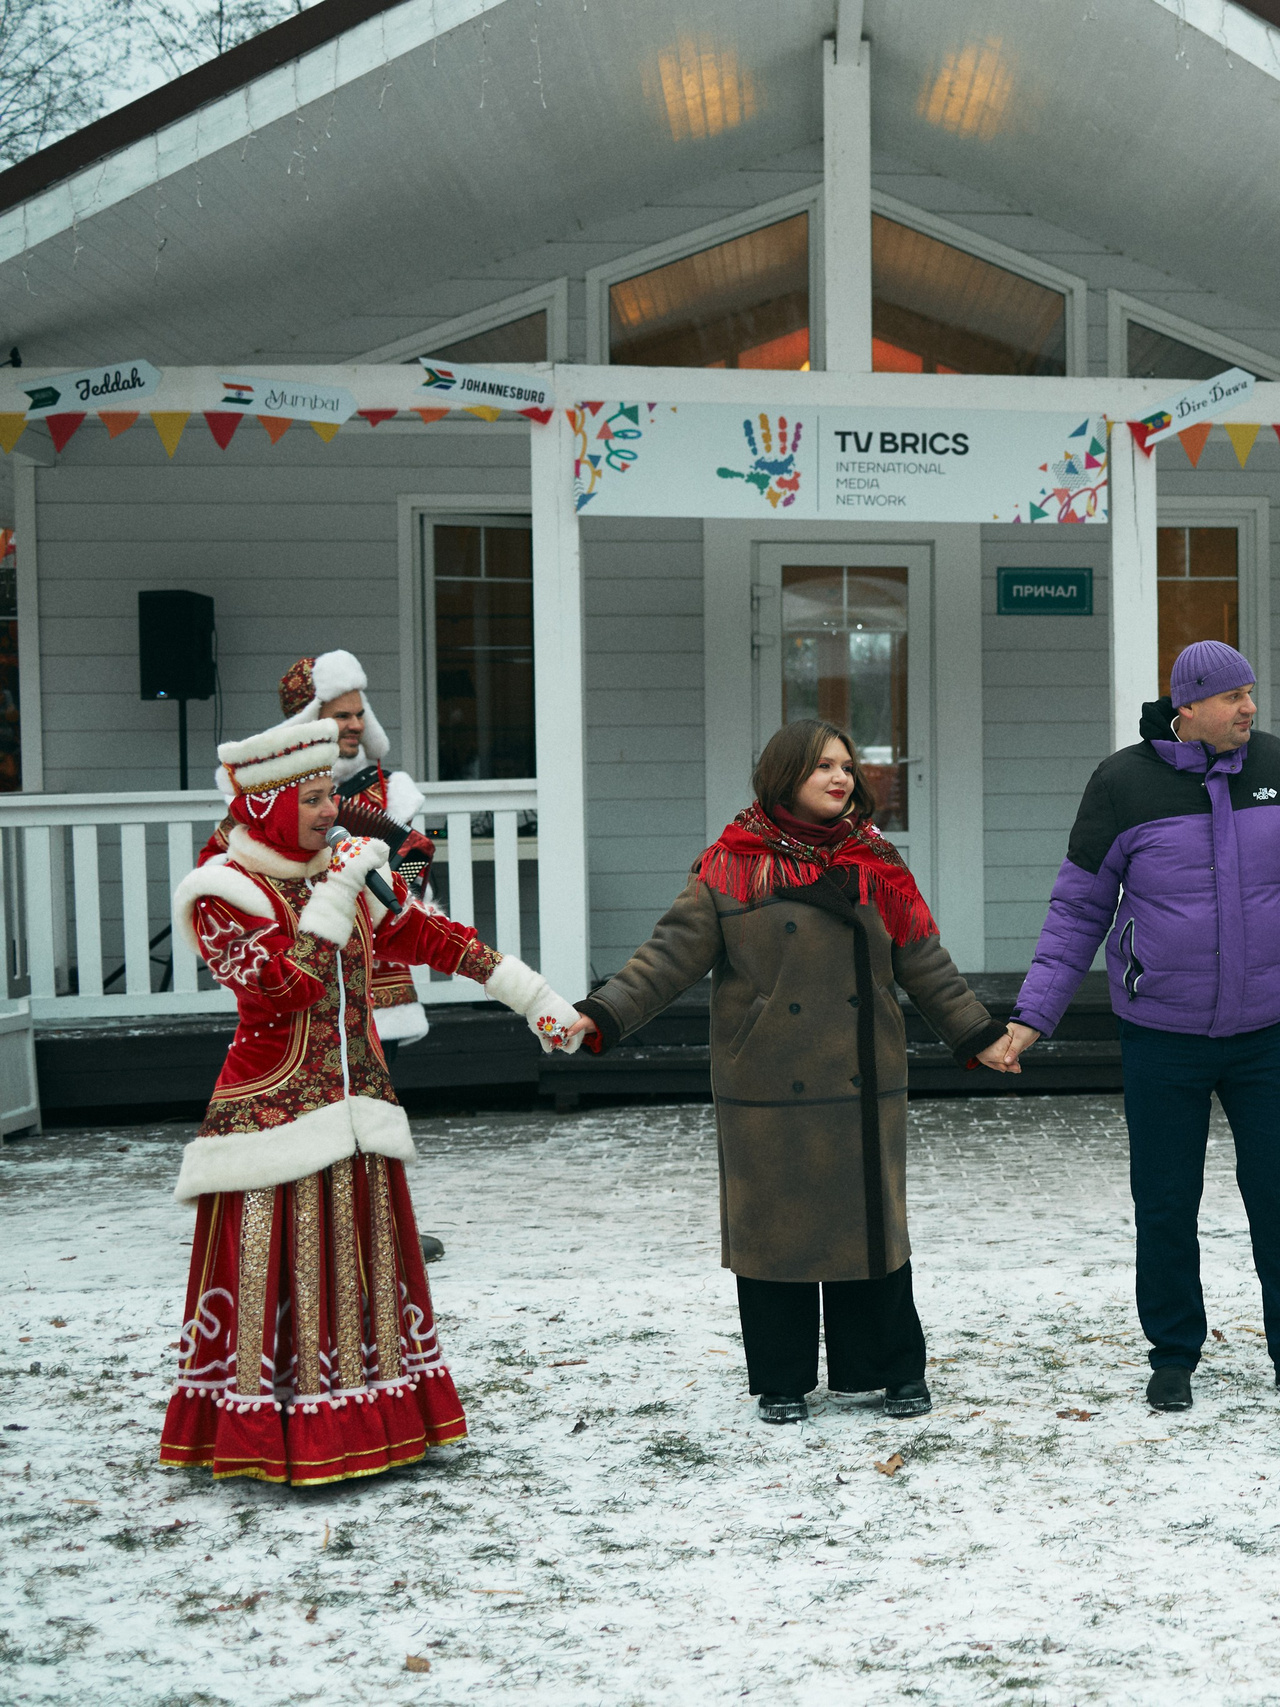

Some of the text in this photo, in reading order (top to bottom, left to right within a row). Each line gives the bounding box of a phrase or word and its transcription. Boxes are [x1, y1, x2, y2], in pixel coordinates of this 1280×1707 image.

[75, 367, 145, 401] Jeddah
[460, 378, 546, 404] JOHANNESBURG
[264, 389, 340, 412] Mumbai
[1175, 397, 1208, 418] Dire
[834, 431, 969, 456] TV BRICS
[836, 461, 946, 475] INTERNATIONAL
[836, 478, 880, 490] MEDIA
[836, 494, 907, 507] NETWORK
[1012, 585, 1077, 598] ПРИЧАЛ
